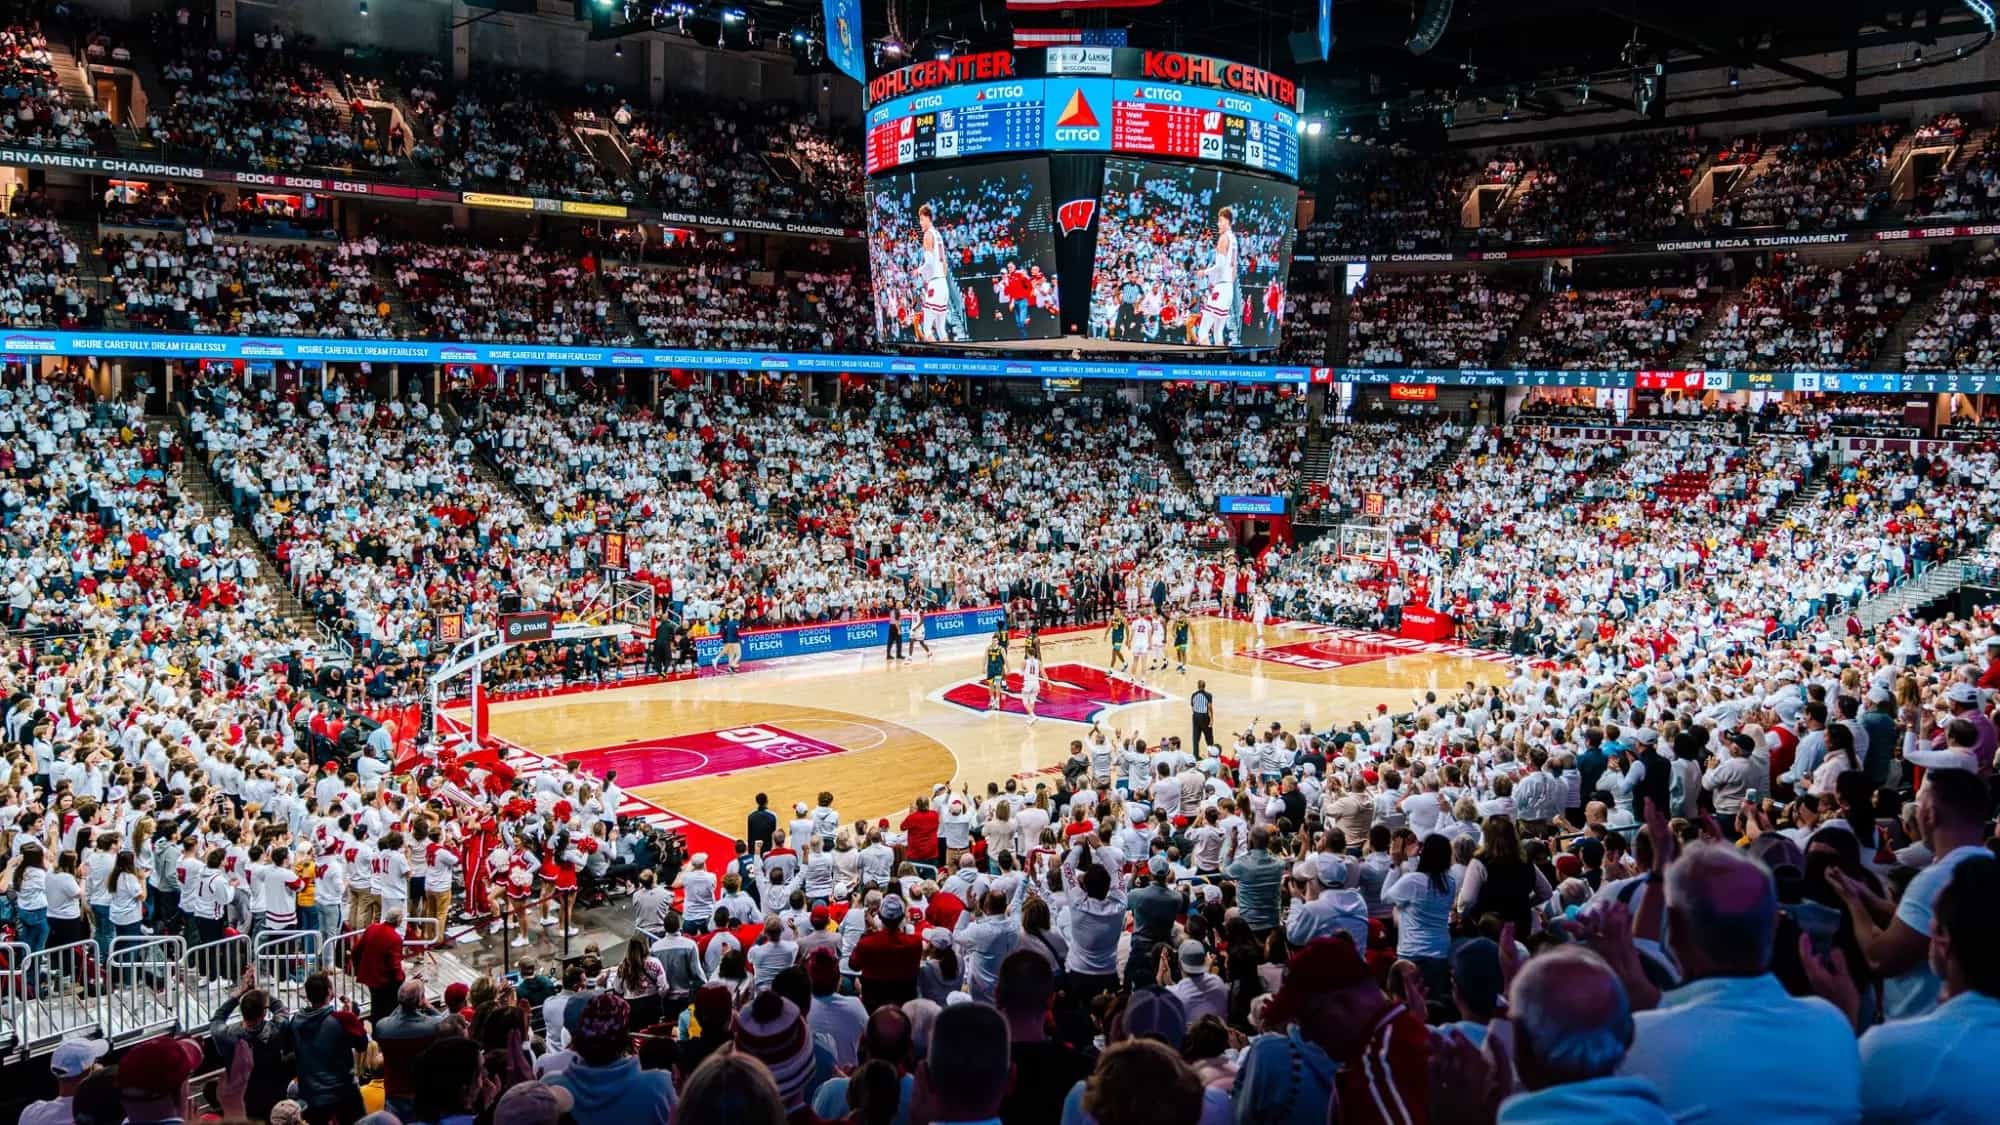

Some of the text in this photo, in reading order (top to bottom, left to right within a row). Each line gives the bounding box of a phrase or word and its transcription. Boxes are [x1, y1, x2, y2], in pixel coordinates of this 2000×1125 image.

[869, 50, 1013, 103] KOHL CENTER
[1143, 49, 1296, 106] KOHL CENTER
[986, 86, 1023, 100] CITGO
[1144, 87, 1182, 102] CITGO
[915, 95, 942, 110] CITGO
[1224, 97, 1252, 113] CITGO
[1226, 116, 1245, 129] 9:48
[1056, 128, 1100, 141] CITGO
[941, 136, 953, 149] 13
[1203, 138, 1220, 151] 20
[900, 144, 912, 156] 20
[1250, 145, 1260, 158] 13
[0, 151, 204, 179] RNAMENT CHAMPIONS
[236, 172, 275, 185] 2004
[334, 181, 368, 193] 2015
[1057, 200, 1096, 237] W
[662, 212, 697, 223] MEN'S
[699, 215, 730, 226] NCAA
[732, 219, 783, 231] NATIONAL
[786, 223, 845, 237] CHAMPIONS
[1876, 230, 1910, 241] 1992
[1922, 226, 1955, 237] 1995
[1656, 233, 1849, 251] WOMEN'S NCAA TOURNAMENT
[1320, 254, 1368, 263] WOMEN'S
[1370, 254, 1388, 263] NIT
[1392, 252, 1453, 262] CHAMPIONS
[1482, 252, 1508, 261] 2000
[72, 340, 102, 349] INSURE
[152, 342, 180, 351] DREAM
[181, 342, 227, 352] FEARLESSLY
[298, 345, 323, 354] INSURE
[364, 346, 389, 356] DREAM
[390, 348, 429, 357] FEARLESSLY
[489, 350, 511, 359] INSURE
[546, 352, 568, 360] DREAM
[1340, 374, 1390, 383] 6/14 43%
[1400, 375, 1416, 384] 2/7
[1538, 377, 1545, 385] 6
[1580, 377, 1587, 386] 2
[1618, 378, 1625, 386] 2
[1641, 378, 1649, 387] 4
[1707, 376, 1722, 386] 20
[1748, 373, 1773, 383] 9:48
[1801, 378, 1814, 387] 13
[1399, 386, 1426, 396] Quartz
[1859, 382, 1892, 391] 6 4
[1903, 382, 1984, 391] 2 1 2 7
[1366, 500, 1380, 513] 30
[935, 614, 963, 622] GORDON
[976, 610, 1004, 618] GORDON
[936, 620, 964, 631] FLESCH
[978, 616, 1005, 625] FLESCH
[443, 625, 457, 637] 30
[523, 622, 547, 632] EVANS
[798, 627, 831, 637] GORDON
[846, 623, 877, 631] GORDON
[1137, 625, 1146, 633] 22
[748, 632, 782, 642] GORDON
[800, 634, 832, 647] FLESCH
[848, 629, 878, 641] FLESCH
[698, 646, 725, 657] FLESC
[750, 640, 783, 652] FLESCH
[1030, 665, 1036, 675] 11
